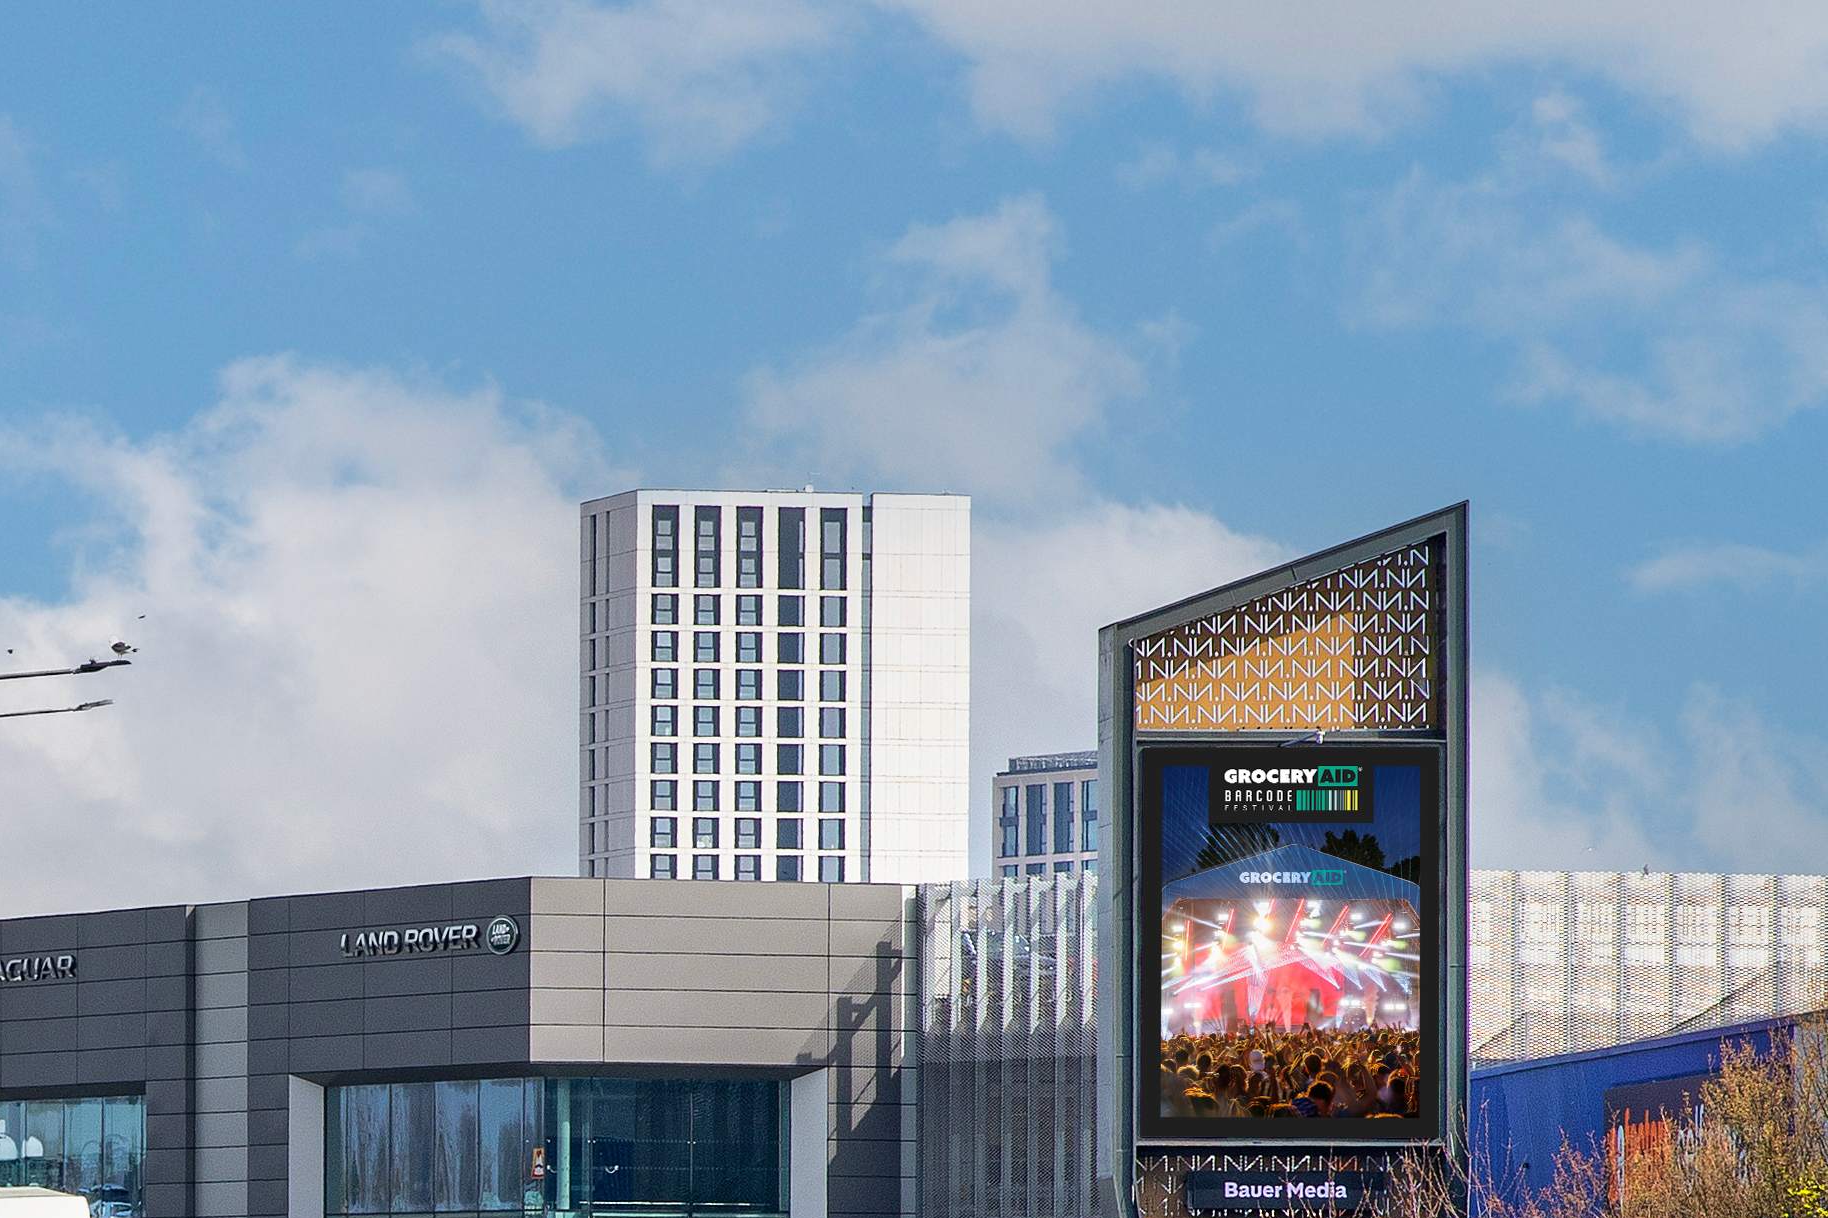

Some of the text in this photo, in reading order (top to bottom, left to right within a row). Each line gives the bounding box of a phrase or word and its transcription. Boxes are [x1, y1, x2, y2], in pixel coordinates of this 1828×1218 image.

[1224, 789, 1292, 802] BARCODE
[340, 925, 479, 957] LAND ROVER
[1224, 1181, 1348, 1199] Bauer Media
